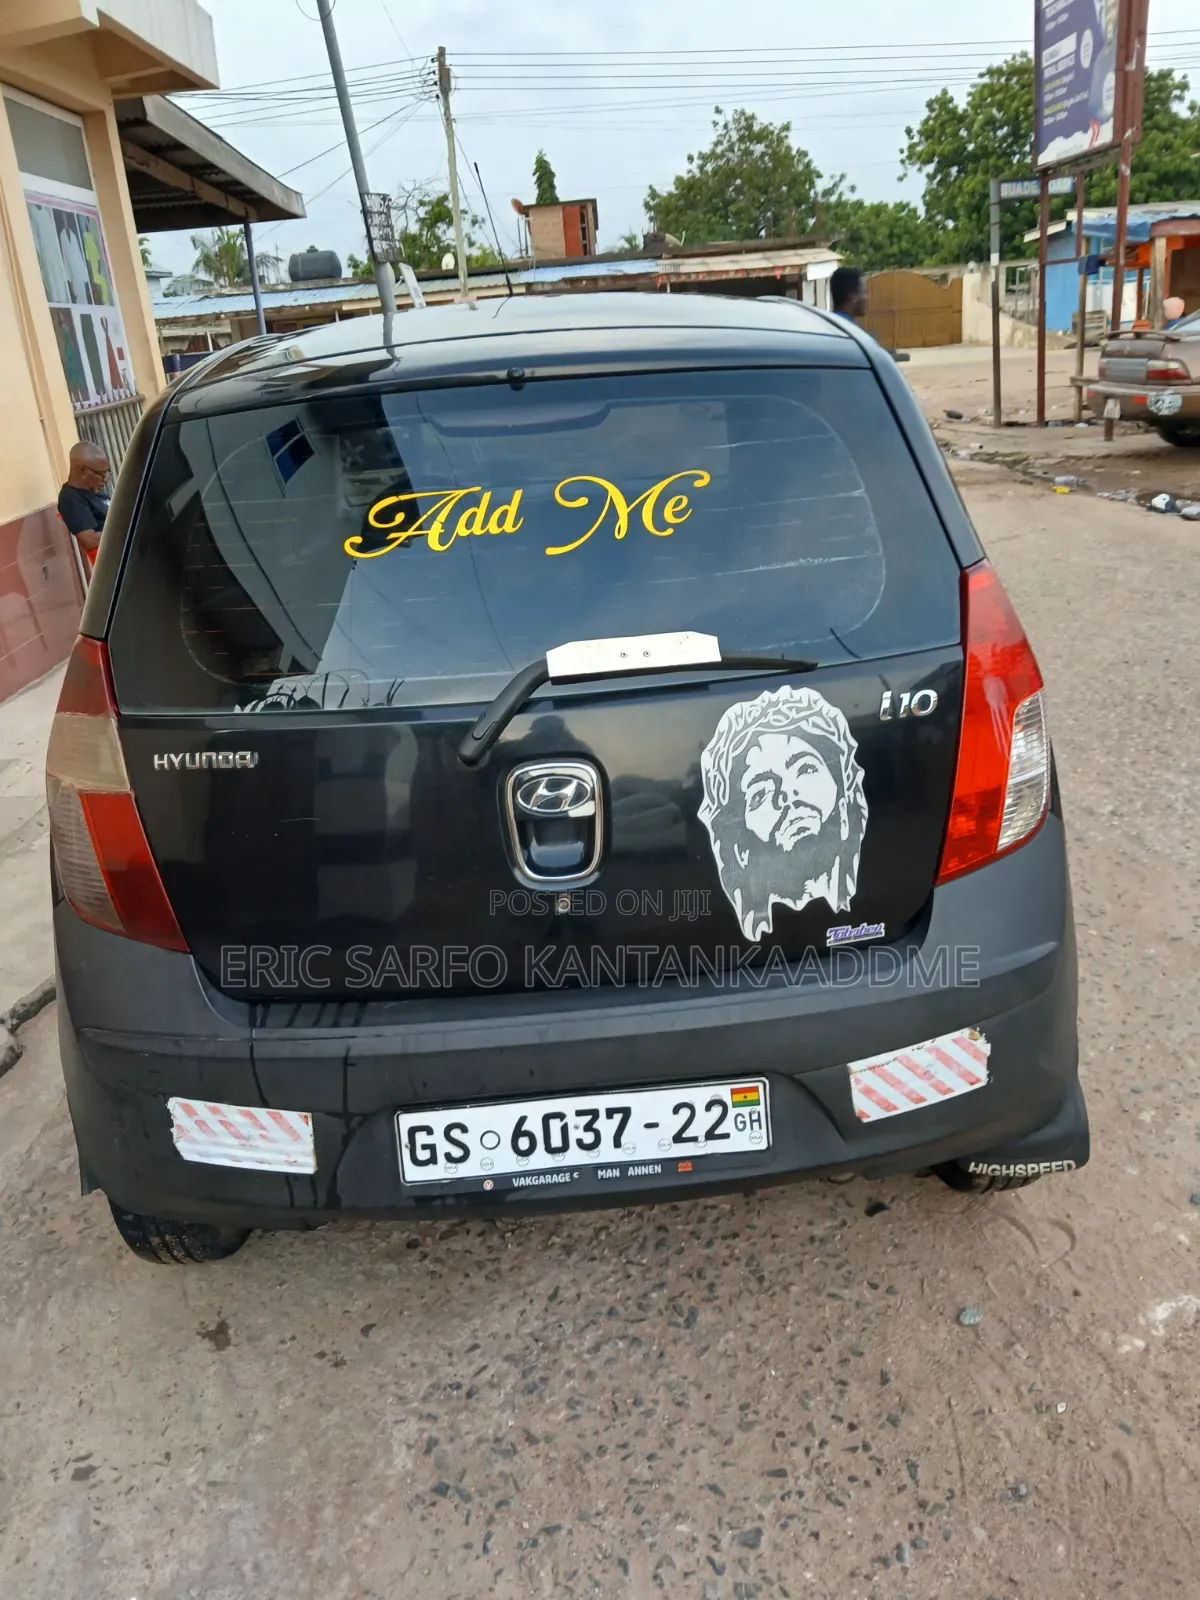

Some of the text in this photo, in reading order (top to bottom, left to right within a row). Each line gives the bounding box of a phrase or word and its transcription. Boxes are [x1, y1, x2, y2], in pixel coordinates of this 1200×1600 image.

[1048, 177, 1070, 194] OAD
[344, 469, 711, 559] Add Me
[879, 689, 939, 721] i10
[153, 751, 259, 770] HYUNDAI
[733, 1110, 762, 1133] GH
[406, 1121, 471, 1168] GS
[512, 1172, 572, 1187] VAKGARAGE
[627, 1163, 662, 1177] ANNEN
[968, 1159, 1077, 1178] HIGHSPEED
